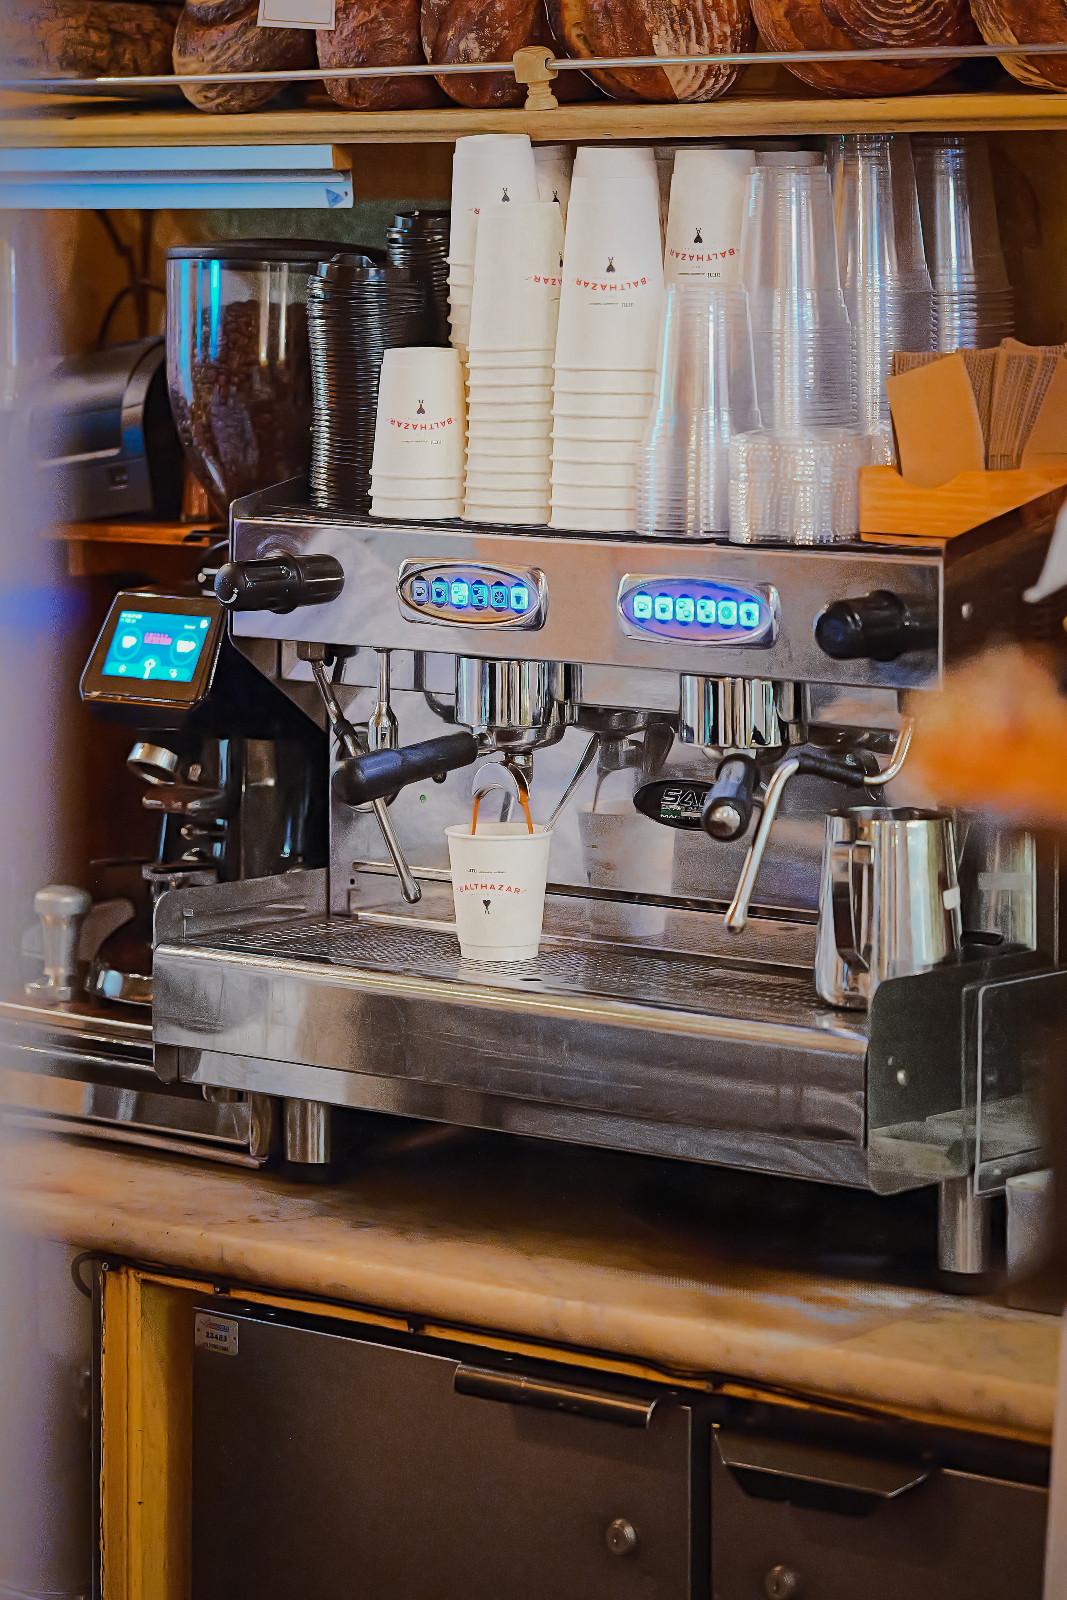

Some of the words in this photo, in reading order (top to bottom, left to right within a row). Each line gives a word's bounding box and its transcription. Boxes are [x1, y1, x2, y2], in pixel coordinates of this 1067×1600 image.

[669, 247, 736, 262] BALTHAZAR
[575, 277, 647, 292] BALTHAZAR
[389, 417, 453, 431] BALTHAZAR
[459, 883, 521, 895] BALTHAZAR
